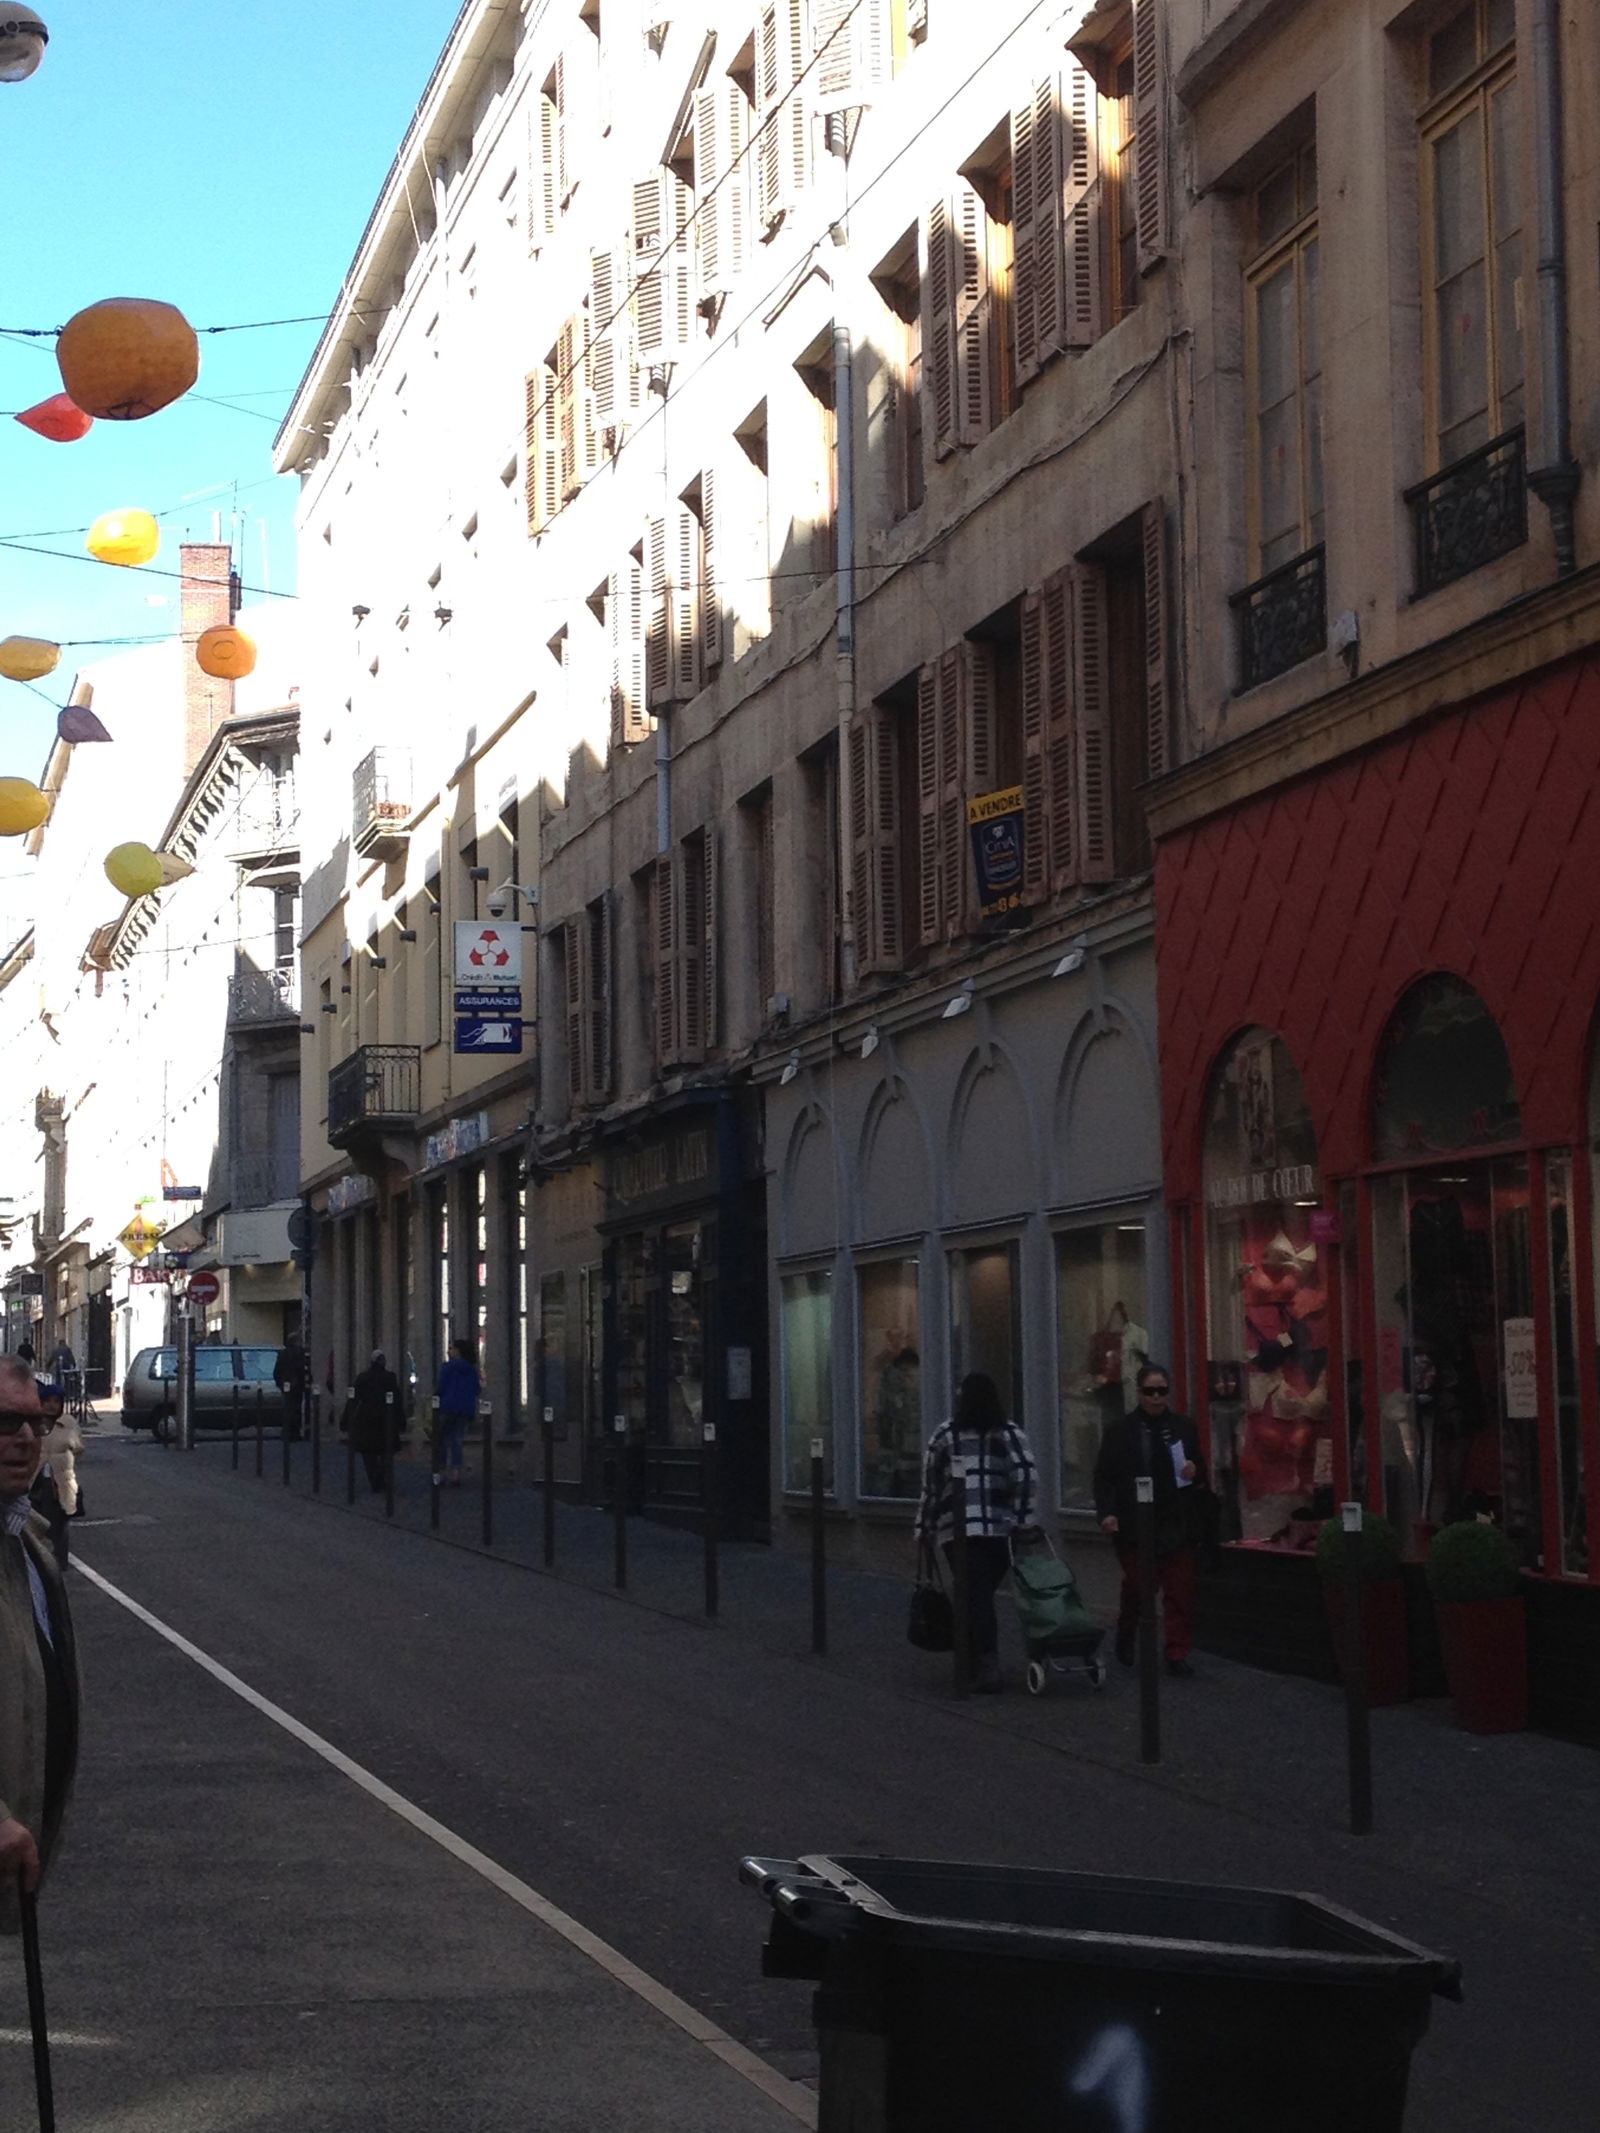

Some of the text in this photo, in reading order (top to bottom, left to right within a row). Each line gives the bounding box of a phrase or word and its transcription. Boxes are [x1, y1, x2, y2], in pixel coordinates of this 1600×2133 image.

[970, 794, 1022, 819] A VENDRE
[459, 997, 519, 1005] ASSURANCES
